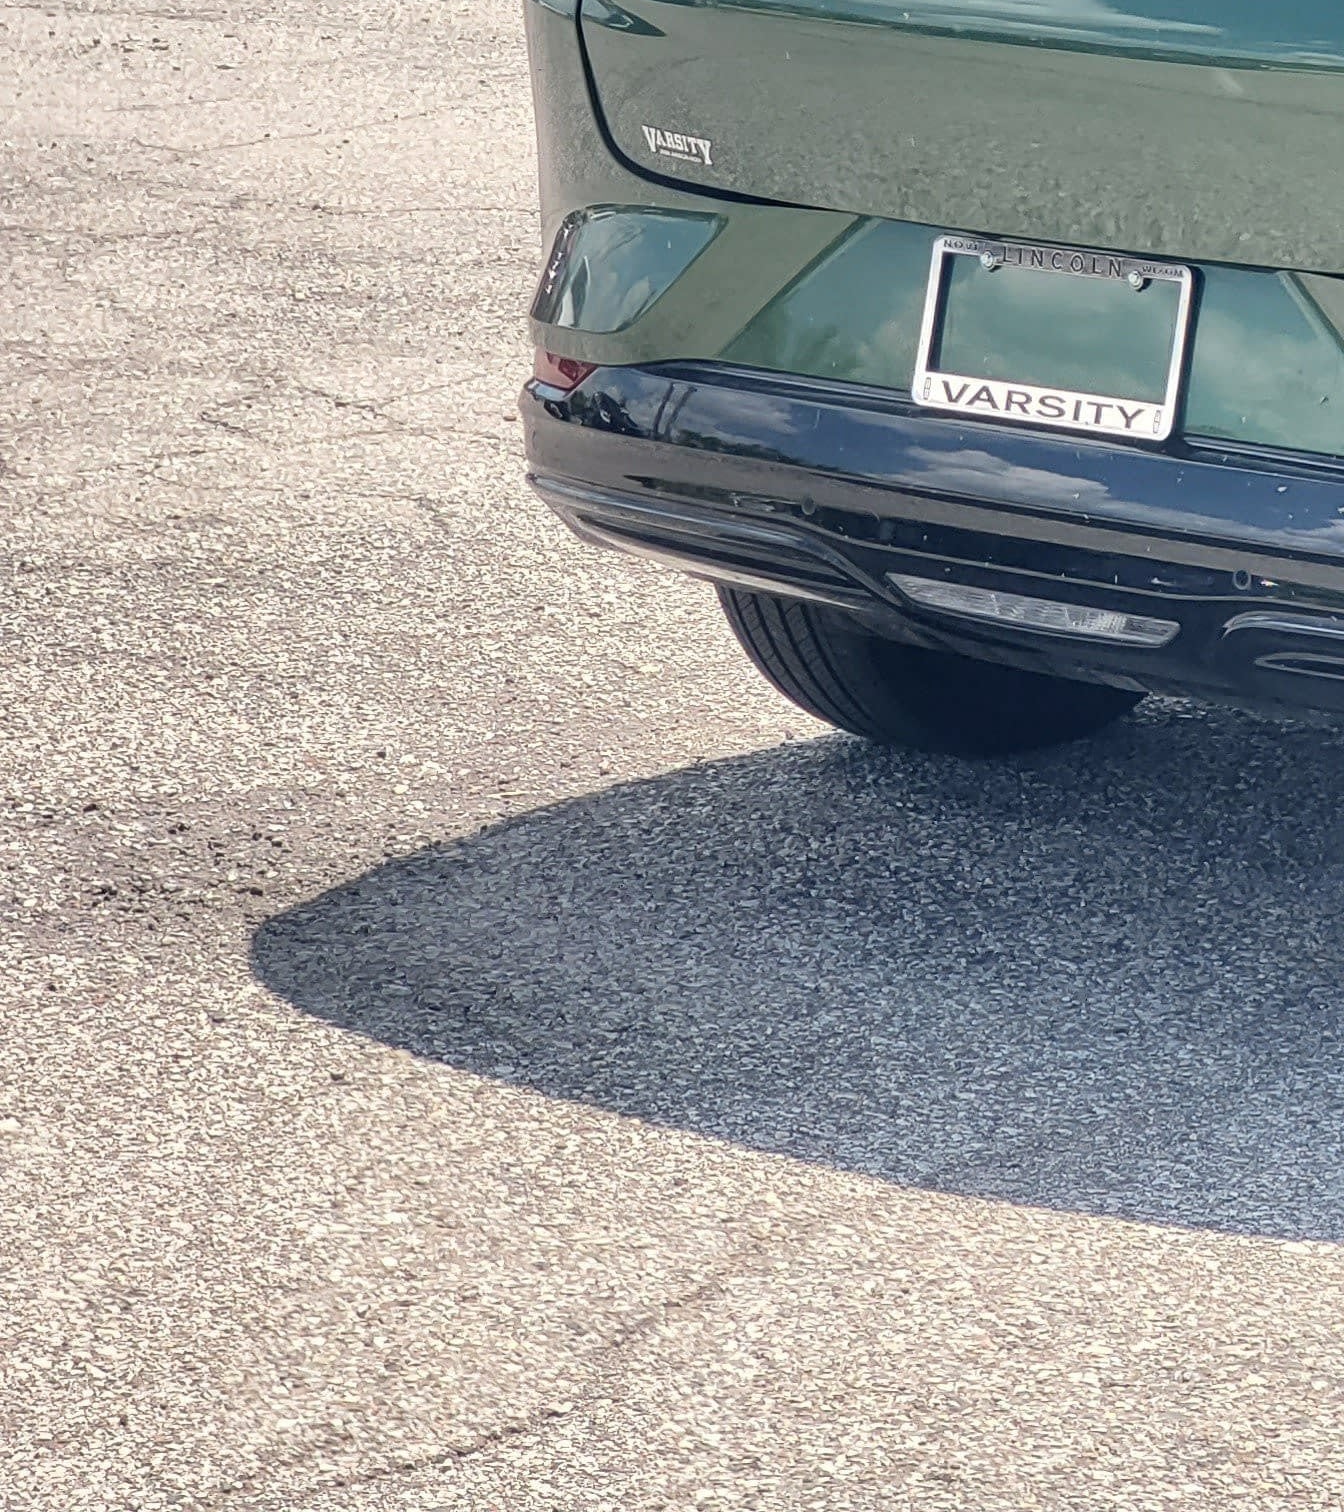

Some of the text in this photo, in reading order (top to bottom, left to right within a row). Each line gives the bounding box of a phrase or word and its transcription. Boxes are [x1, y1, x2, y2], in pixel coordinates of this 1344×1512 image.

[641, 124, 713, 166] VARSITY
[1003, 245, 1121, 278] LINCOLN
[941, 379, 1146, 430] VARSITY
